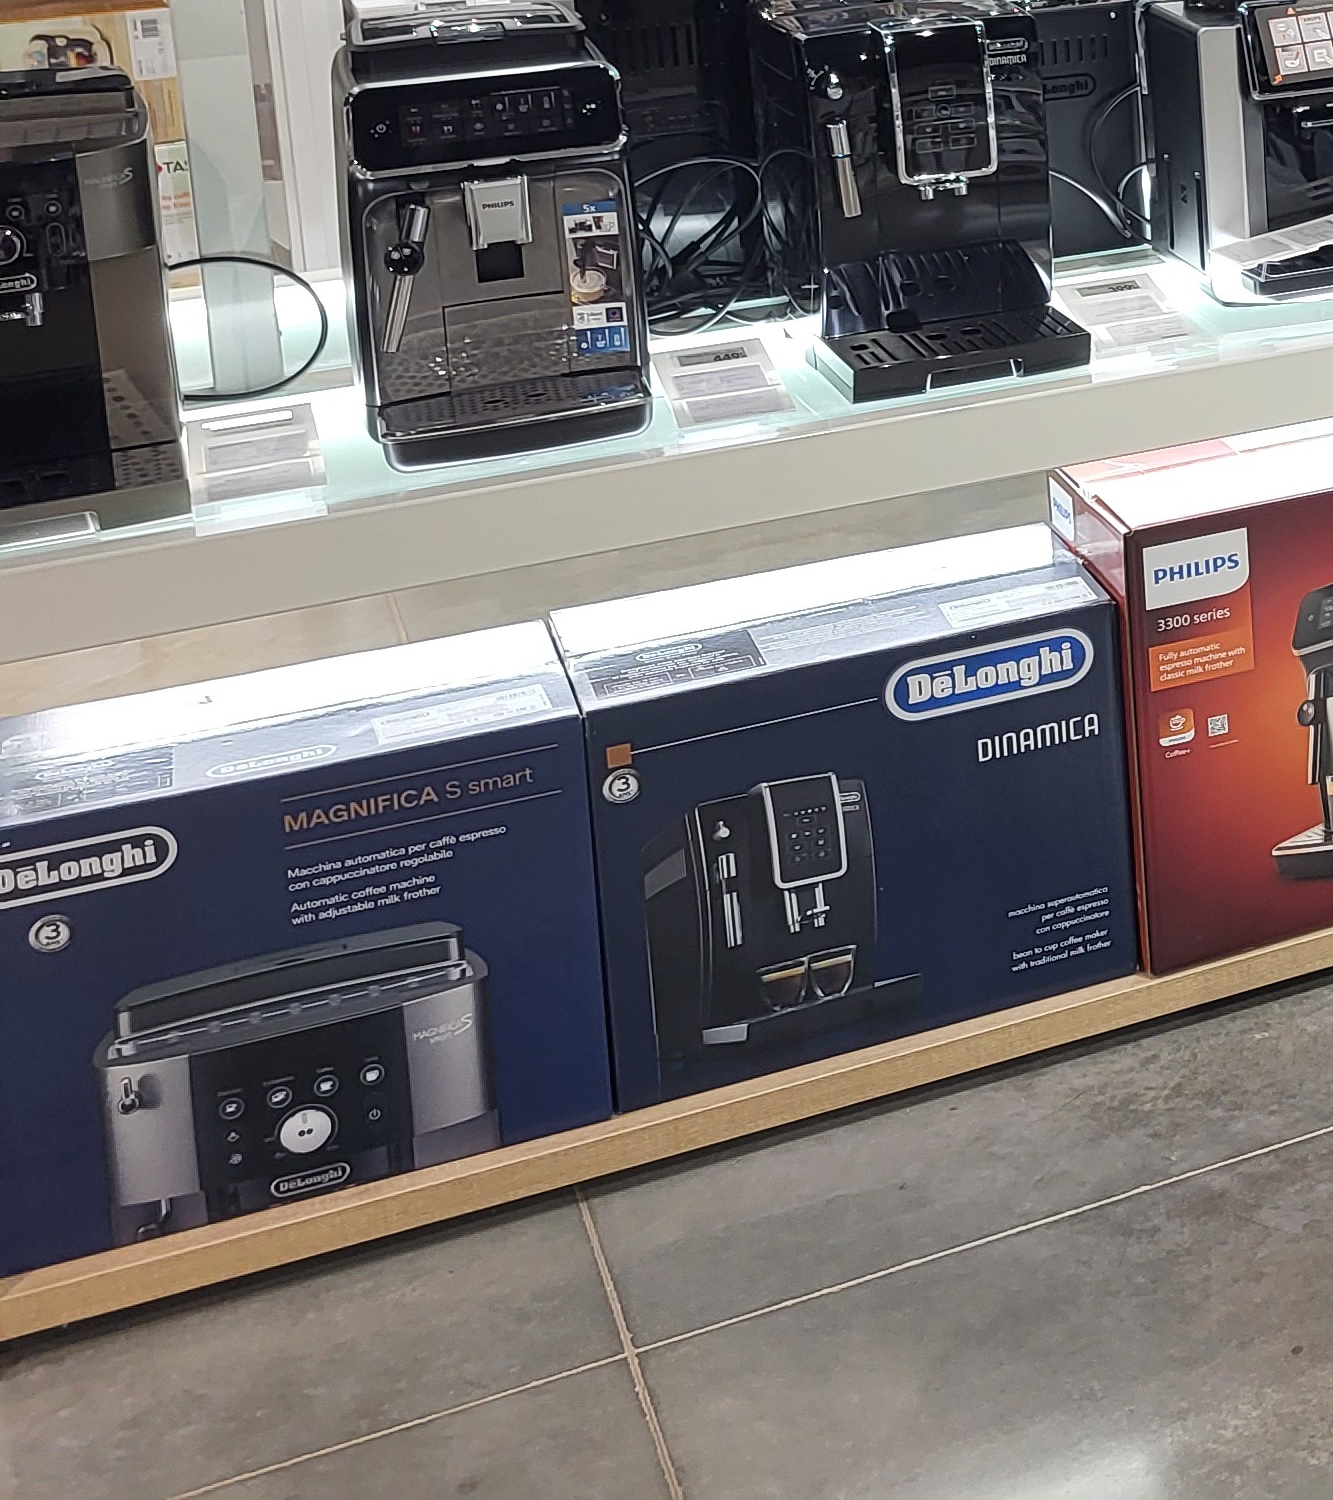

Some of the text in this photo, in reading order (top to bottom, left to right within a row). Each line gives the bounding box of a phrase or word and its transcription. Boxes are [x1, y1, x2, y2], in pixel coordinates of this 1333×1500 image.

[481, 200, 515, 211] PHILIPS
[581, 203, 597, 213] 5x
[1153, 553, 1240, 585] PHILIPS
[1156, 606, 1231, 632] 3300 series
[1158, 642, 1221, 662] Fully automatic
[1159, 646, 1246, 672] espresso machine with
[1159, 659, 1234, 682] classic milk frother
[977, 712, 1100, 763] DINAMICA
[616, 775, 632, 793] 3
[283, 766, 535, 833] MAGNIFICA S smart
[287, 860, 342, 879] Macchina
[344, 846, 407, 868] automatica
[408, 843, 428, 856] per
[458, 826, 508, 845] espresso
[288, 848, 454, 893] con cappuccinatore regolabile
[290, 873, 437, 914] Automatic coffee machine
[291, 884, 442, 927] with adjustable milk frother
[1007, 903, 1046, 918] macchina
[1041, 912, 1055, 924] per
[1076, 898, 1110, 912] espresso
[1035, 925, 1051, 935] con
[1011, 961, 1029, 973] with
[1029, 949, 1069, 968] traditional
[1086, 939, 1112, 953] frother
[1012, 929, 1109, 960] bean to cup coffee maker
